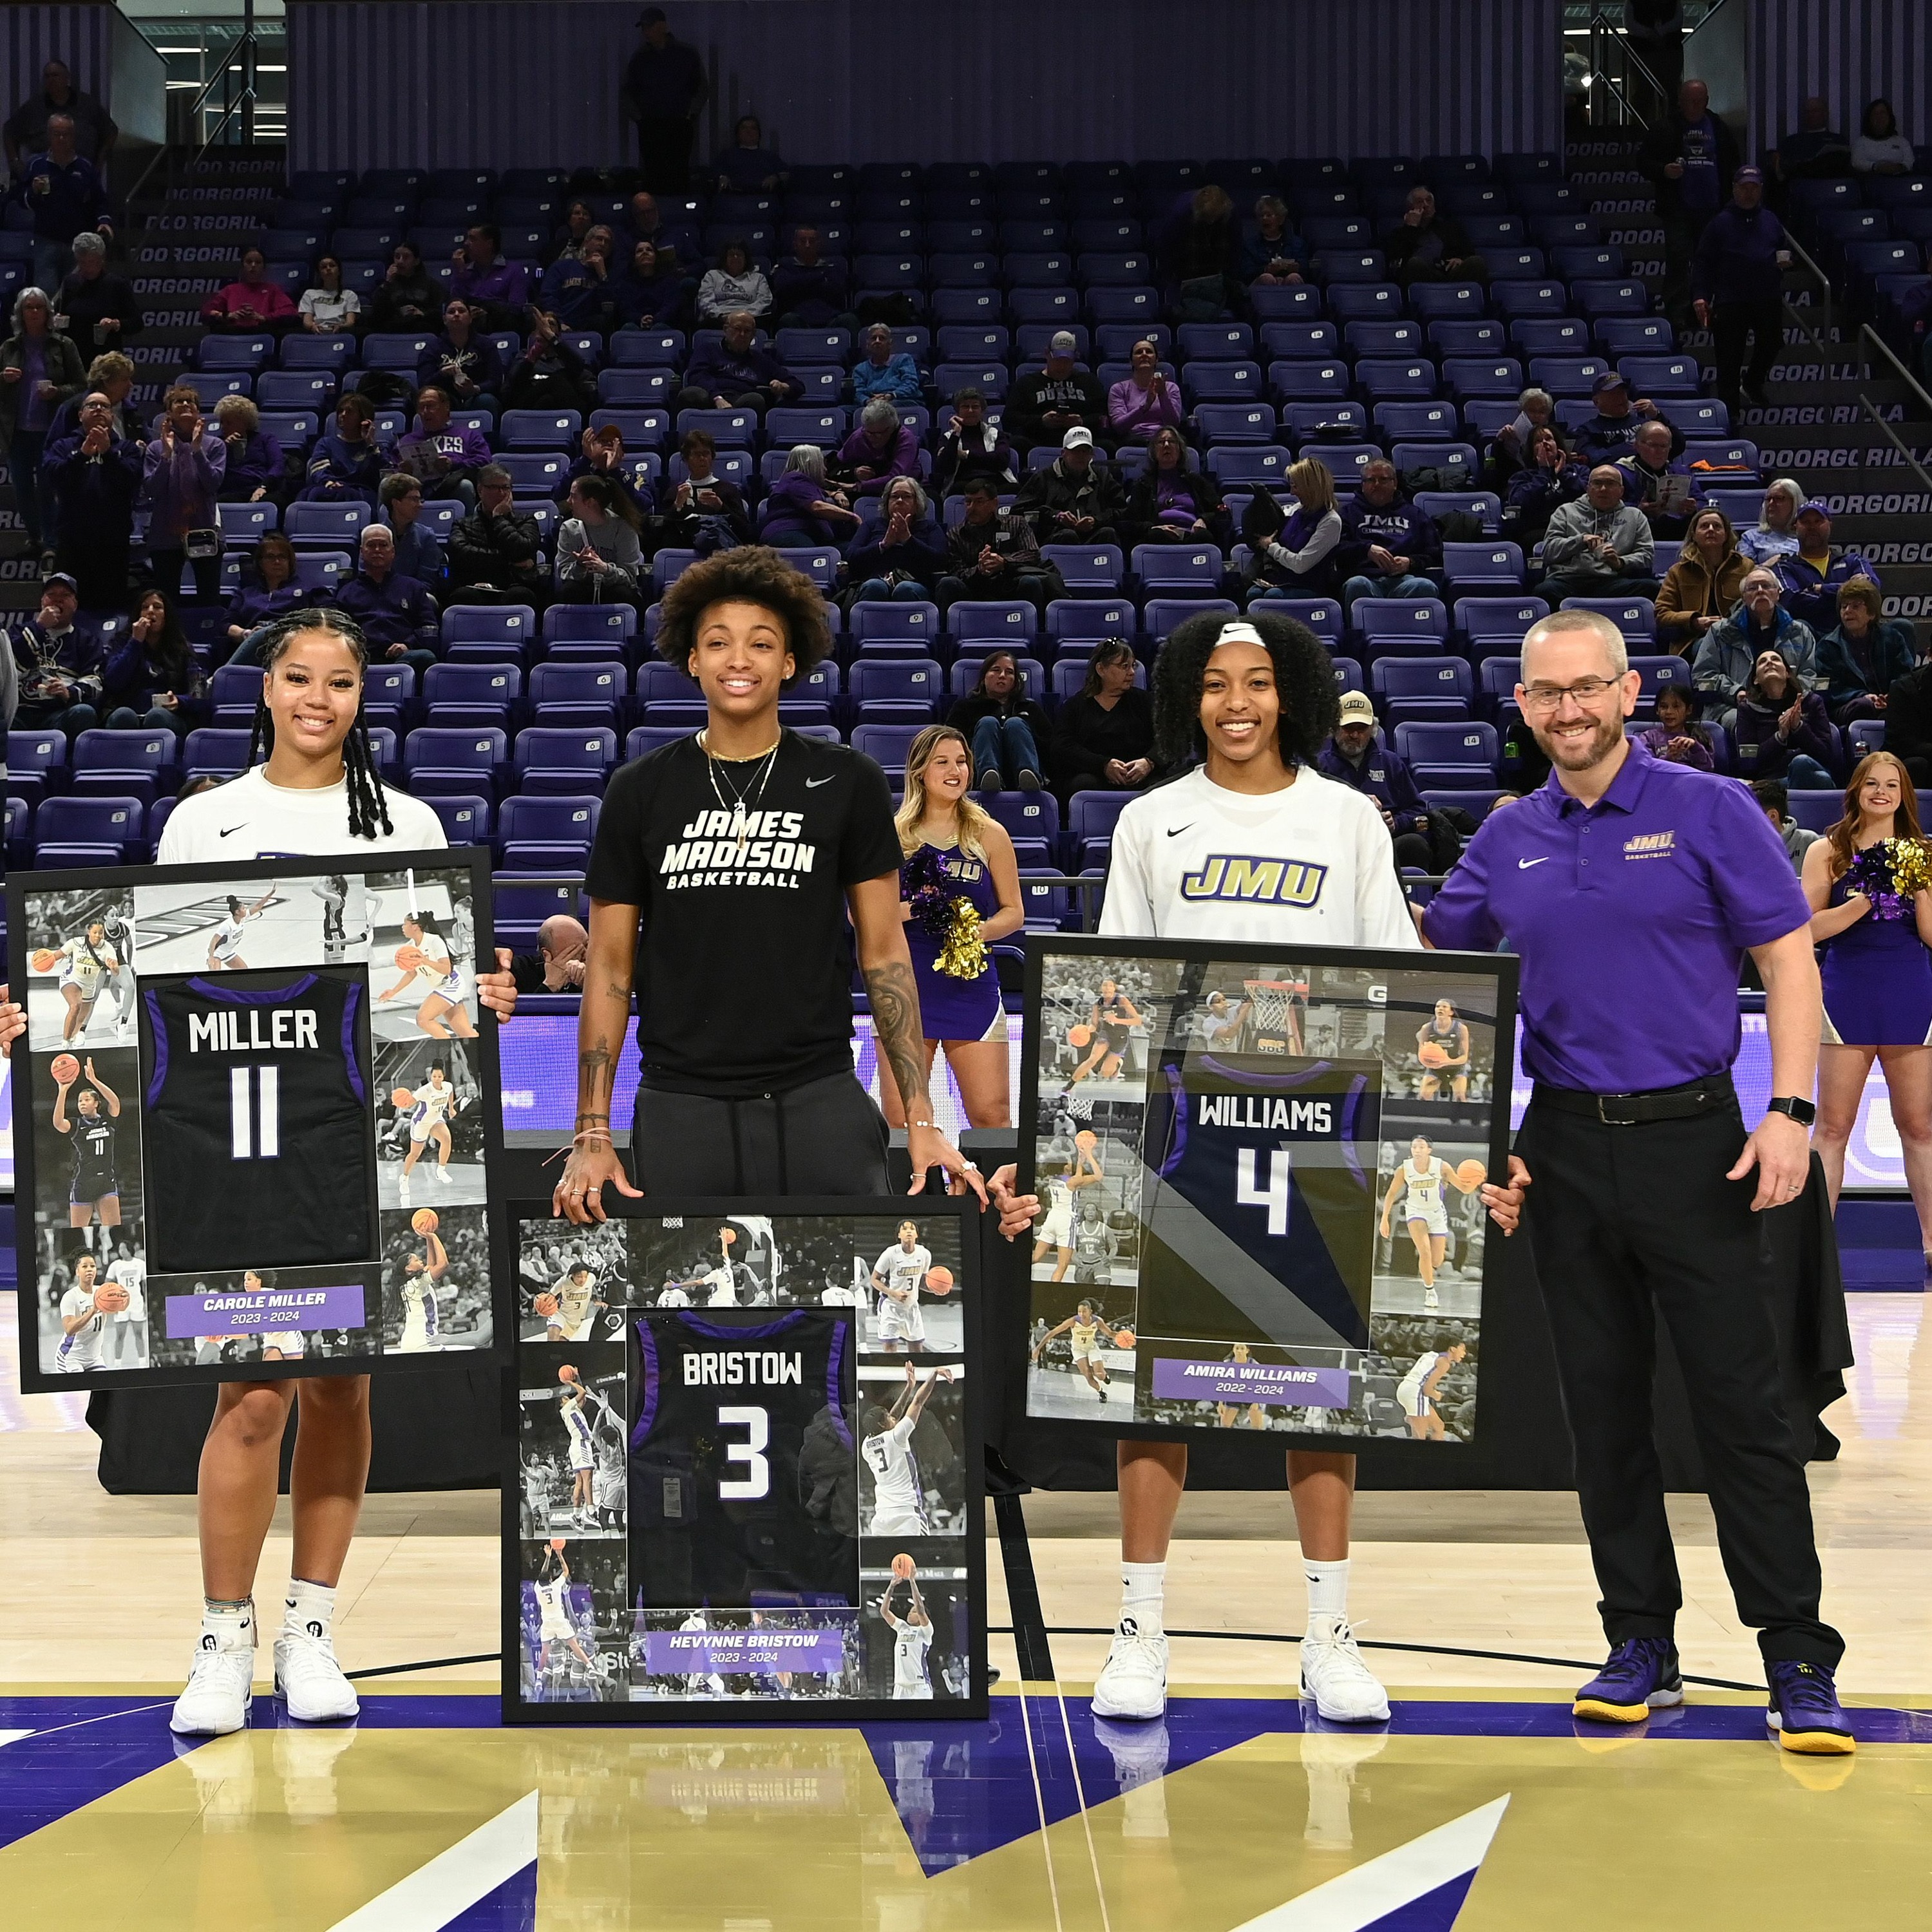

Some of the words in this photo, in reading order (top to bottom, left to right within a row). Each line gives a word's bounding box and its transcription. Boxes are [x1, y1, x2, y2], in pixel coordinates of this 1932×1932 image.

[1046, 381, 1074, 389] JMU
[1036, 389, 1086, 404] DUKES
[1358, 514, 1410, 529] JMU
[1027, 807, 1037, 815] 10
[683, 810, 804, 839] JAMES
[1625, 832, 1673, 850] JMU
[659, 841, 815, 875] MADISON
[1625, 851, 1672, 860] BASKETBALL
[666, 872, 800, 890] BASKETBALL
[1184, 857, 1324, 906] JMU
[189, 1009, 319, 1053] MILLER
[229, 1065, 280, 1159] 11
[1198, 1095, 1332, 1133] WILLIAMS
[95, 1139, 104, 1155] 11
[1236, 1147, 1290, 1235] 4
[1420, 1189, 1428, 1202] 4
[1085, 1244, 1095, 1255] 12
[897, 1265, 922, 1276] JMU
[126, 1277, 135, 1287] 15
[907, 1278, 914, 1291] 3
[204, 1295, 265, 1311] CAROLE
[268, 1293, 327, 1308] MILLER
[93, 1316, 102, 1332] 11
[231, 1313, 261, 1325] 2023
[270, 1311, 300, 1323] 2024
[683, 1352, 802, 1386] BRISTOW
[1184, 1363, 1236, 1379] AMIRA
[1239, 1366, 1318, 1384] WILLIAMS
[1215, 1383, 1246, 1393] 2022
[1253, 1384, 1285, 1396] 2024
[717, 1406, 771, 1501] 3
[874, 1448, 889, 1473] 3
[545, 1593, 553, 1604] 3
[670, 1634, 744, 1649] HEVYNNE
[747, 1634, 819, 1647] BRISTOW
[710, 1653, 740, 1663] 2023
[748, 1653, 778, 1663] 2024
[902, 1644, 908, 1657] 3
